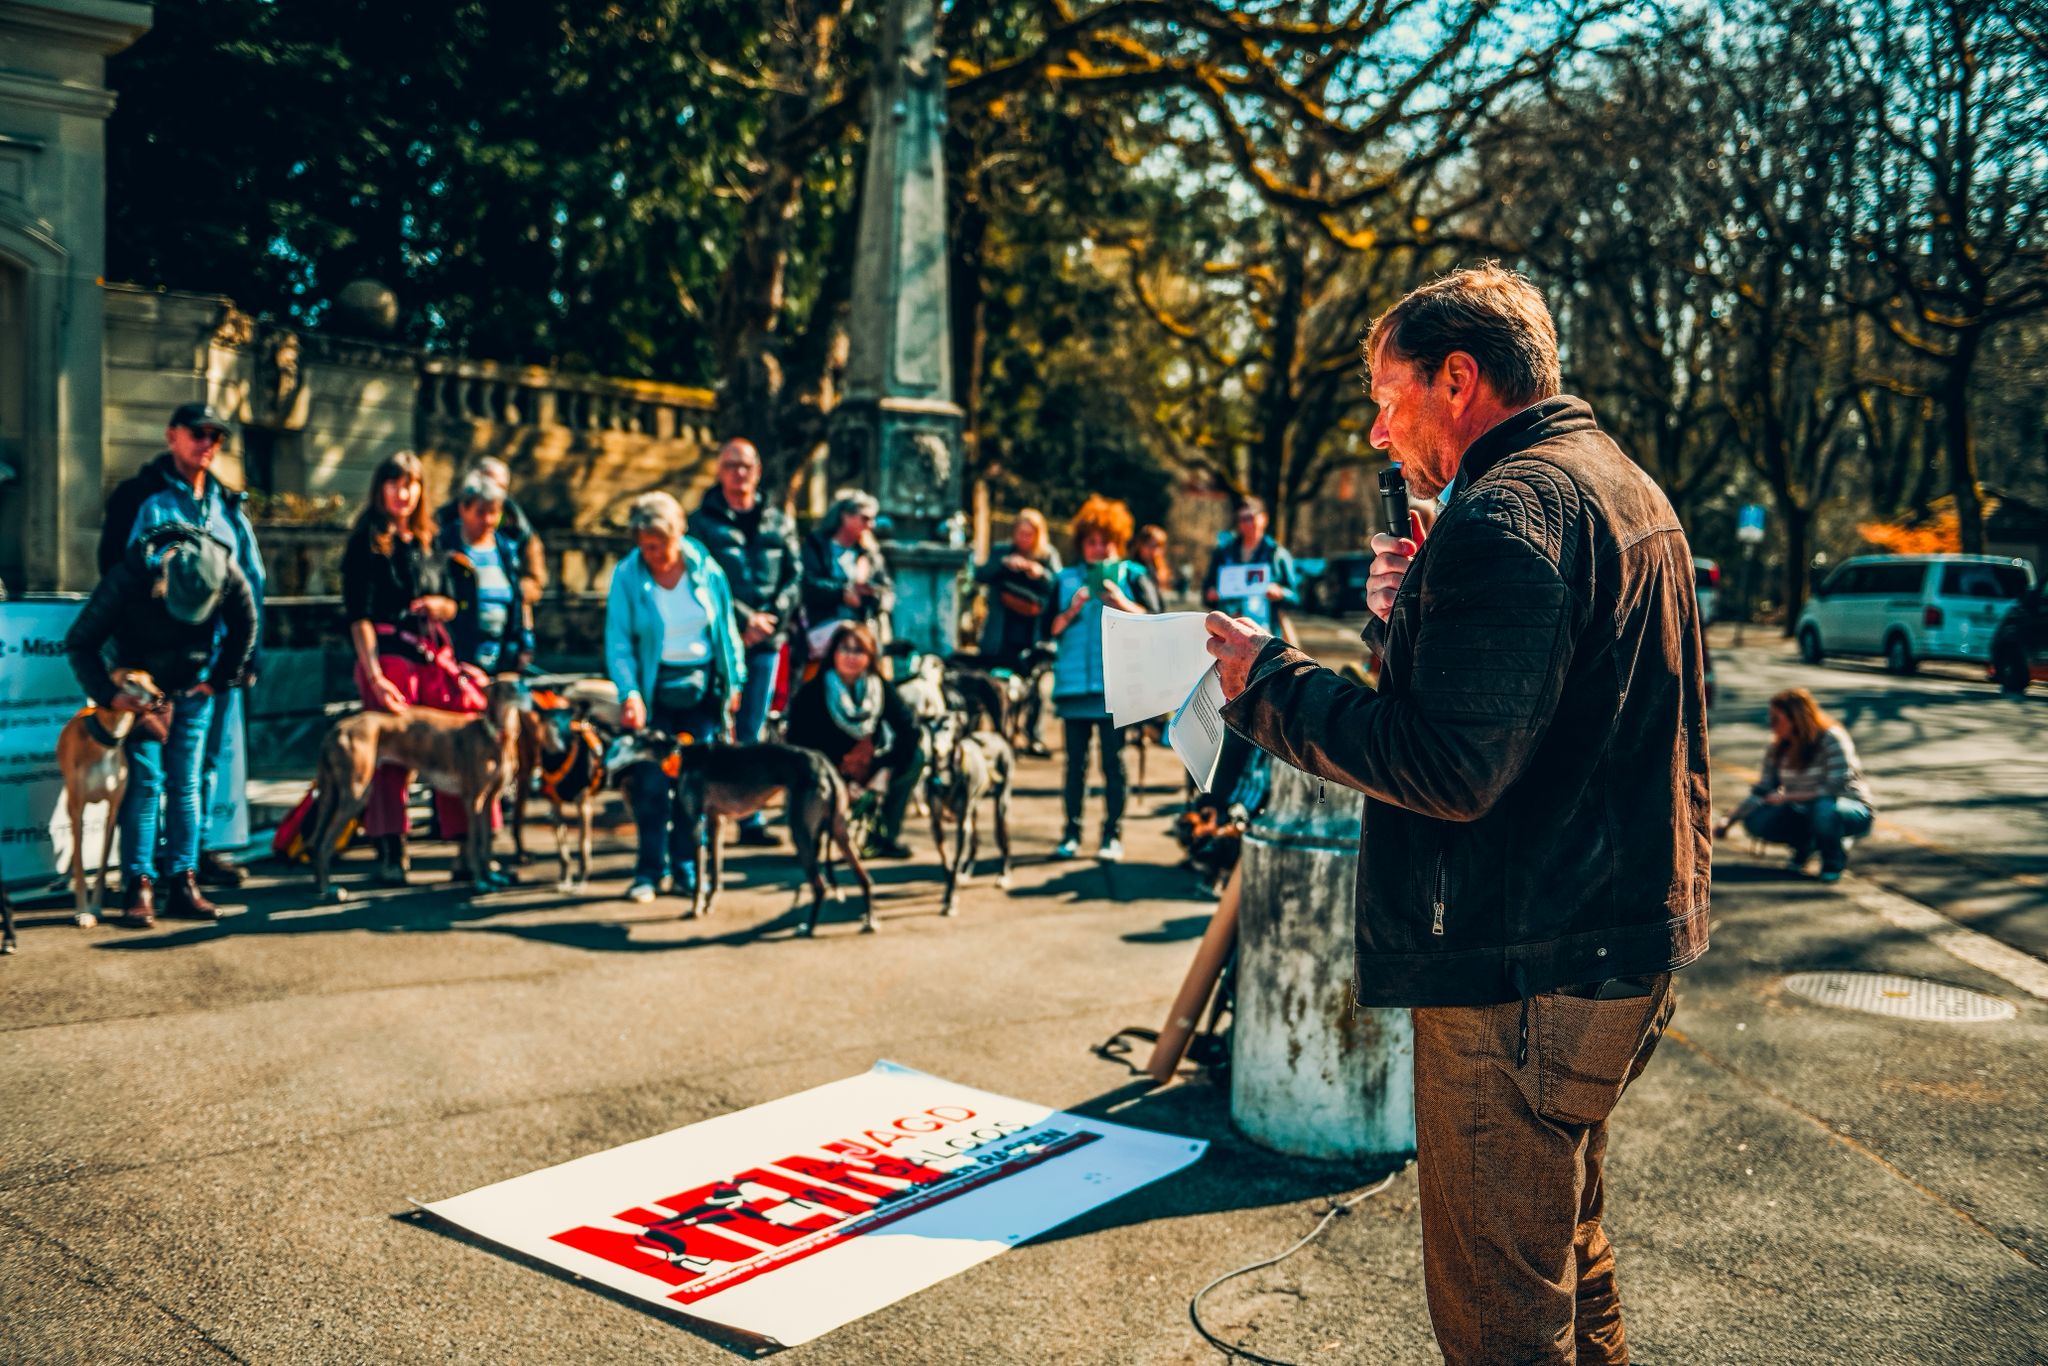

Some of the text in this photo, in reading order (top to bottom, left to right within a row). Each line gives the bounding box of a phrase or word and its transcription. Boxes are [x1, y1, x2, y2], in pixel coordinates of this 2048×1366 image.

[836, 1105, 978, 1161] JAGD
[872, 1120, 1031, 1178] GALGOS
[547, 1141, 948, 1287] NEIN
